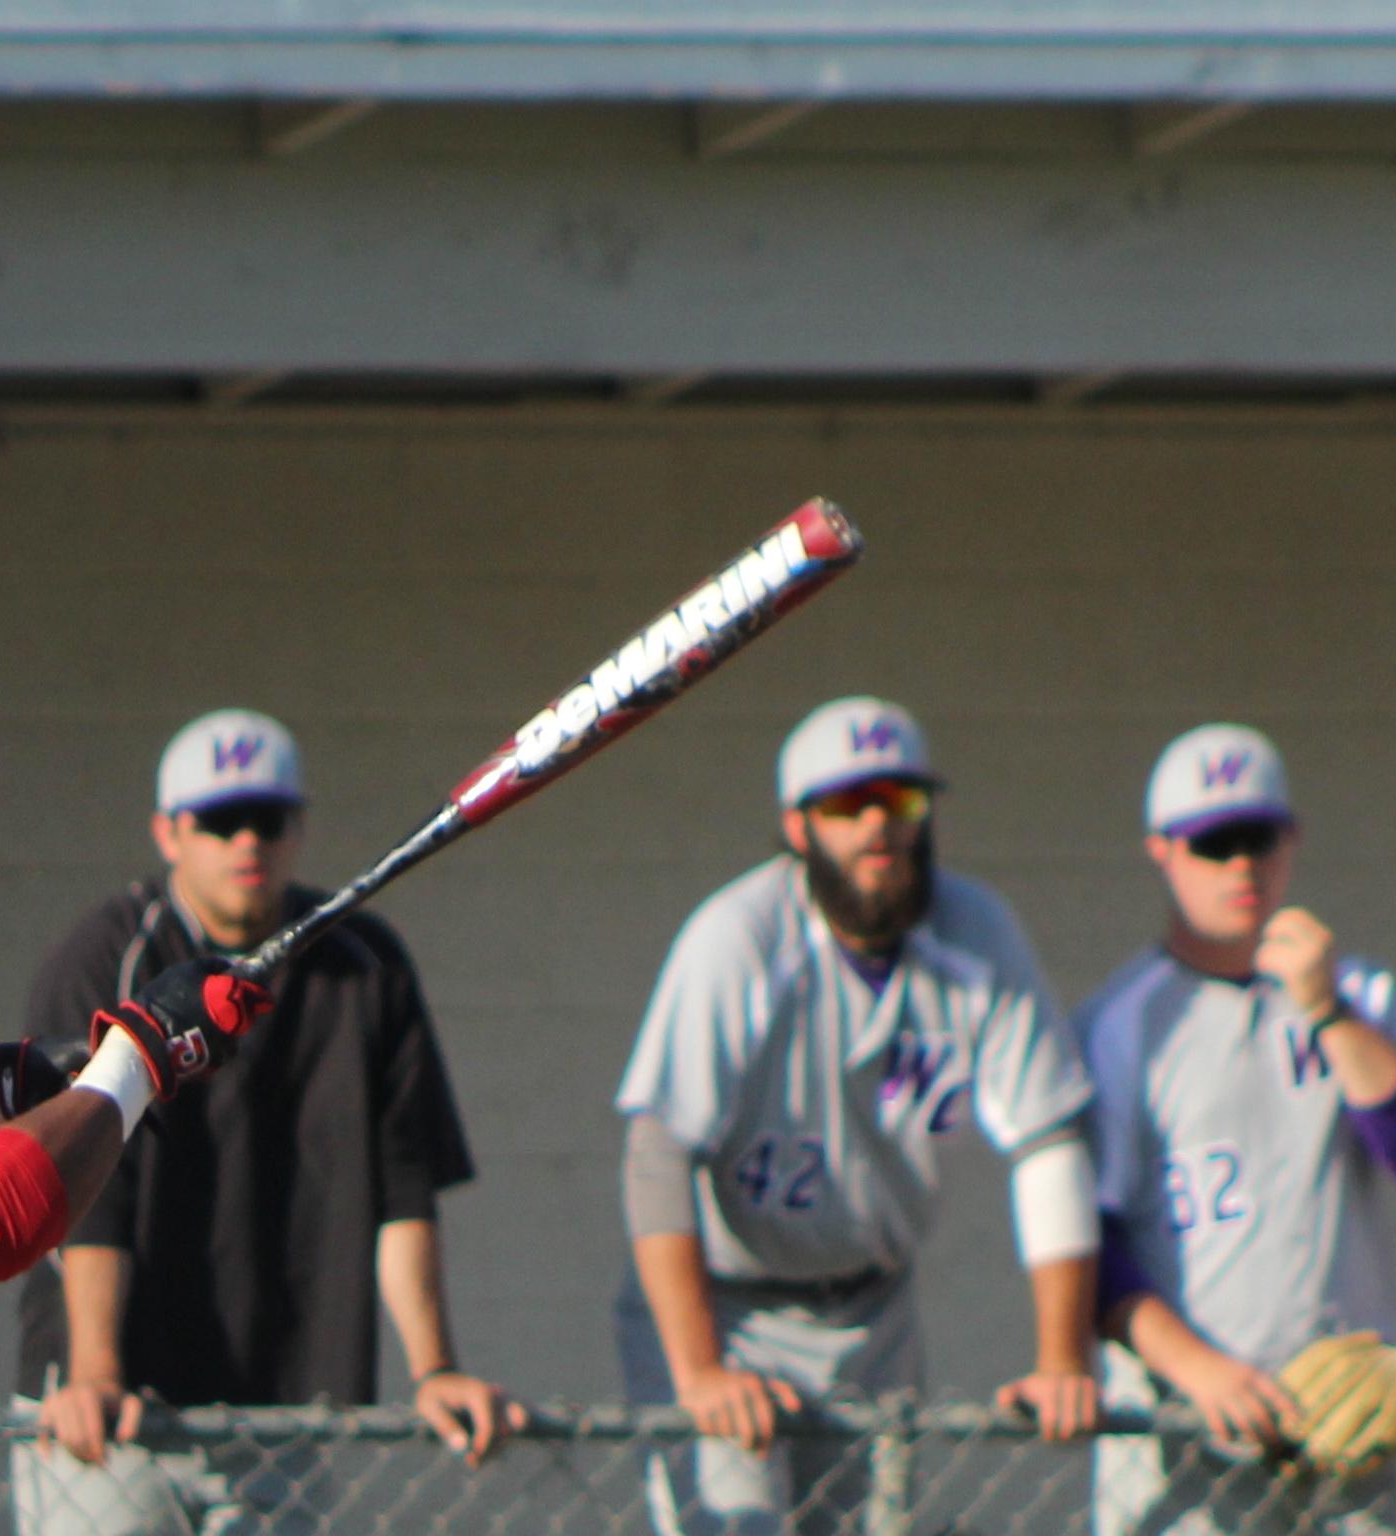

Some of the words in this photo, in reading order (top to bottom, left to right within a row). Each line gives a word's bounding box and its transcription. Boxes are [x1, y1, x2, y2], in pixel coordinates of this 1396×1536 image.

[513, 520, 809, 771] DeMARINI
[212, 735, 266, 773] W
[850, 717, 901, 754] W
[1201, 753, 1250, 788] W
[734, 1138, 828, 1213] 42
